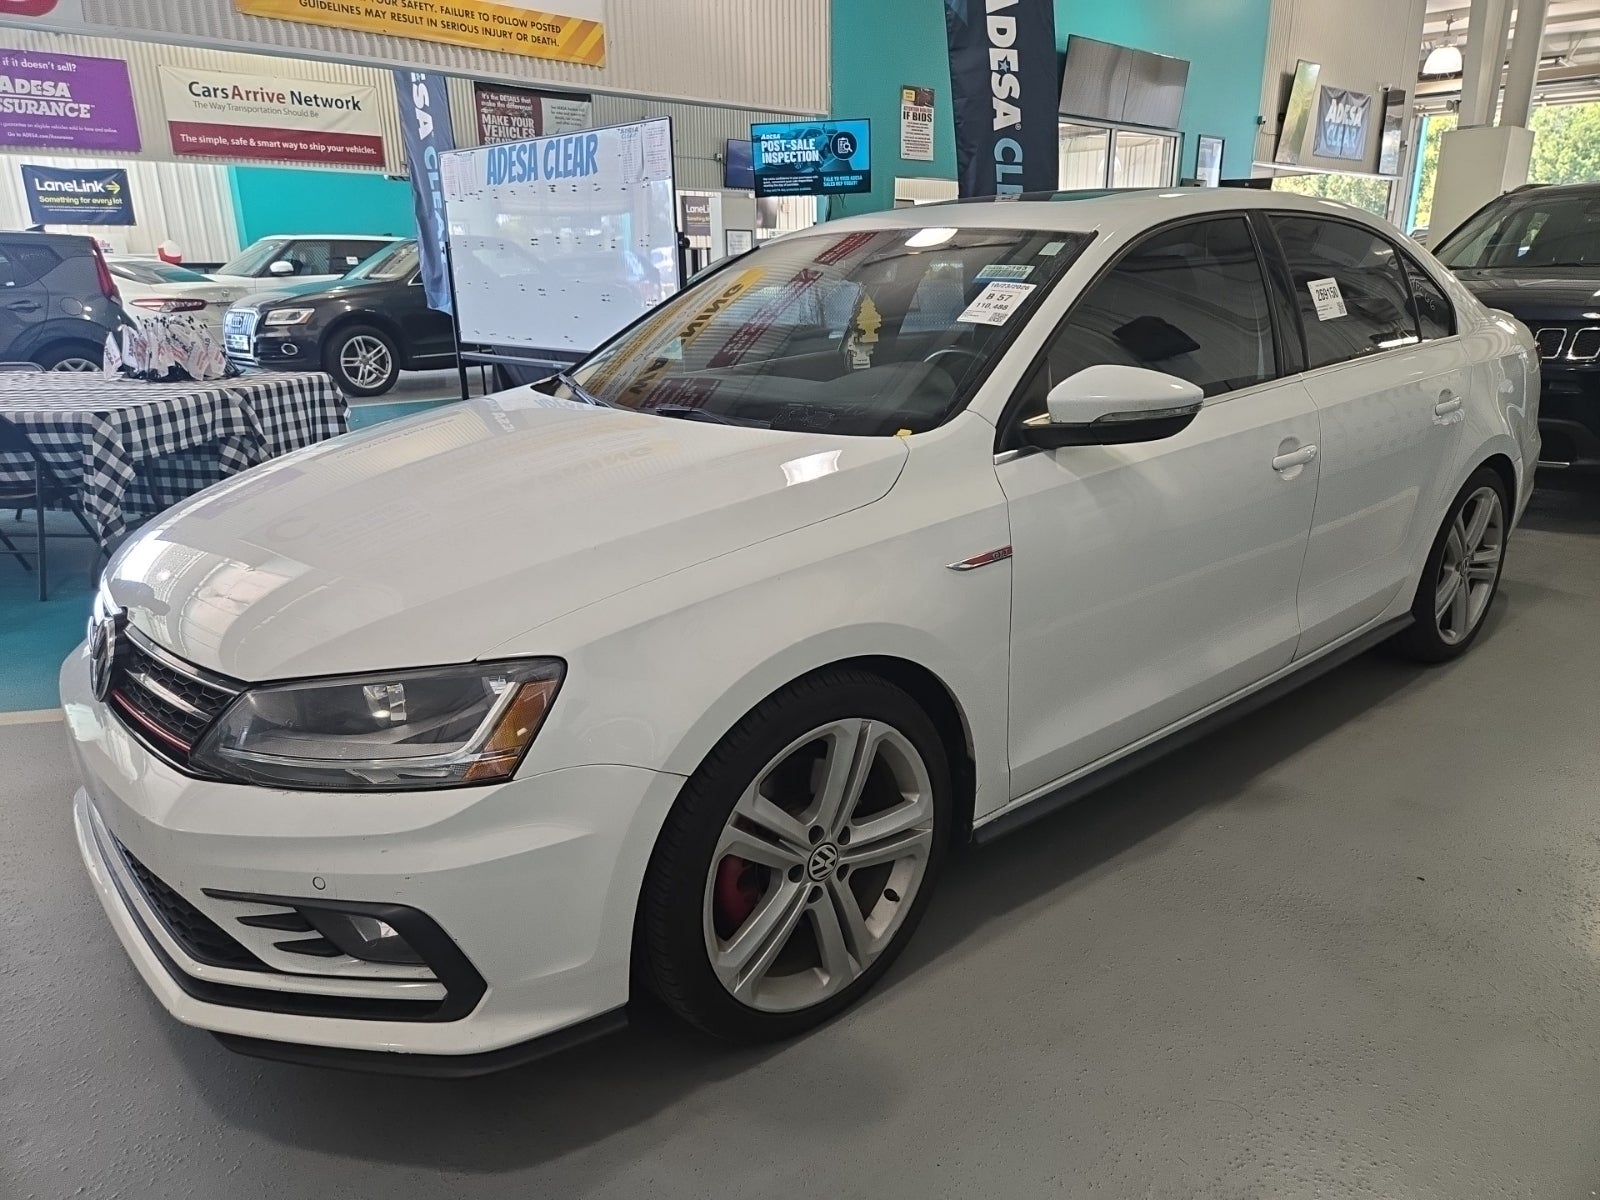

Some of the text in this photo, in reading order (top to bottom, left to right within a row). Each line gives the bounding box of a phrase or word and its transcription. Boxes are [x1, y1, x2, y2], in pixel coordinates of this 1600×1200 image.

[300, 0, 560, 47] GUIDELINES MAY RESULT IN SERIOUS INJURY OR DEATH.
[401, 0, 438, 13] SAFETY.
[440, 5, 475, 19] FAILURE
[478, 11, 490, 22] TO
[493, 14, 527, 28] FOLLOW
[531, 21, 561, 34] POSTED
[2, 57, 77, 72] if it doesn't sell?
[0, 75, 71, 98] ADESA
[290, 90, 362, 111] Network
[193, 100, 319, 118] The Way Transportation Should Be
[903, 110, 933, 122] IF BIDS
[1325, 98, 1363, 127] ADESA
[482, 113, 535, 129] MAKE YOUR
[483, 124, 535, 139] VEHICLES
[180, 133, 377, 154] The simple, safe & smart way to ship your vehicles.
[761, 138, 816, 152] POST-SALE
[486, 143, 538, 185] ADESA
[543, 133, 598, 181] CLEAR
[762, 150, 820, 164] INSPECTION
[35, 178, 105, 193] LaneLink
[38, 195, 80, 205] Something
[80, 196, 90, 204] for
[92, 197, 112, 206] every
[996, 294, 1013, 302] 57
